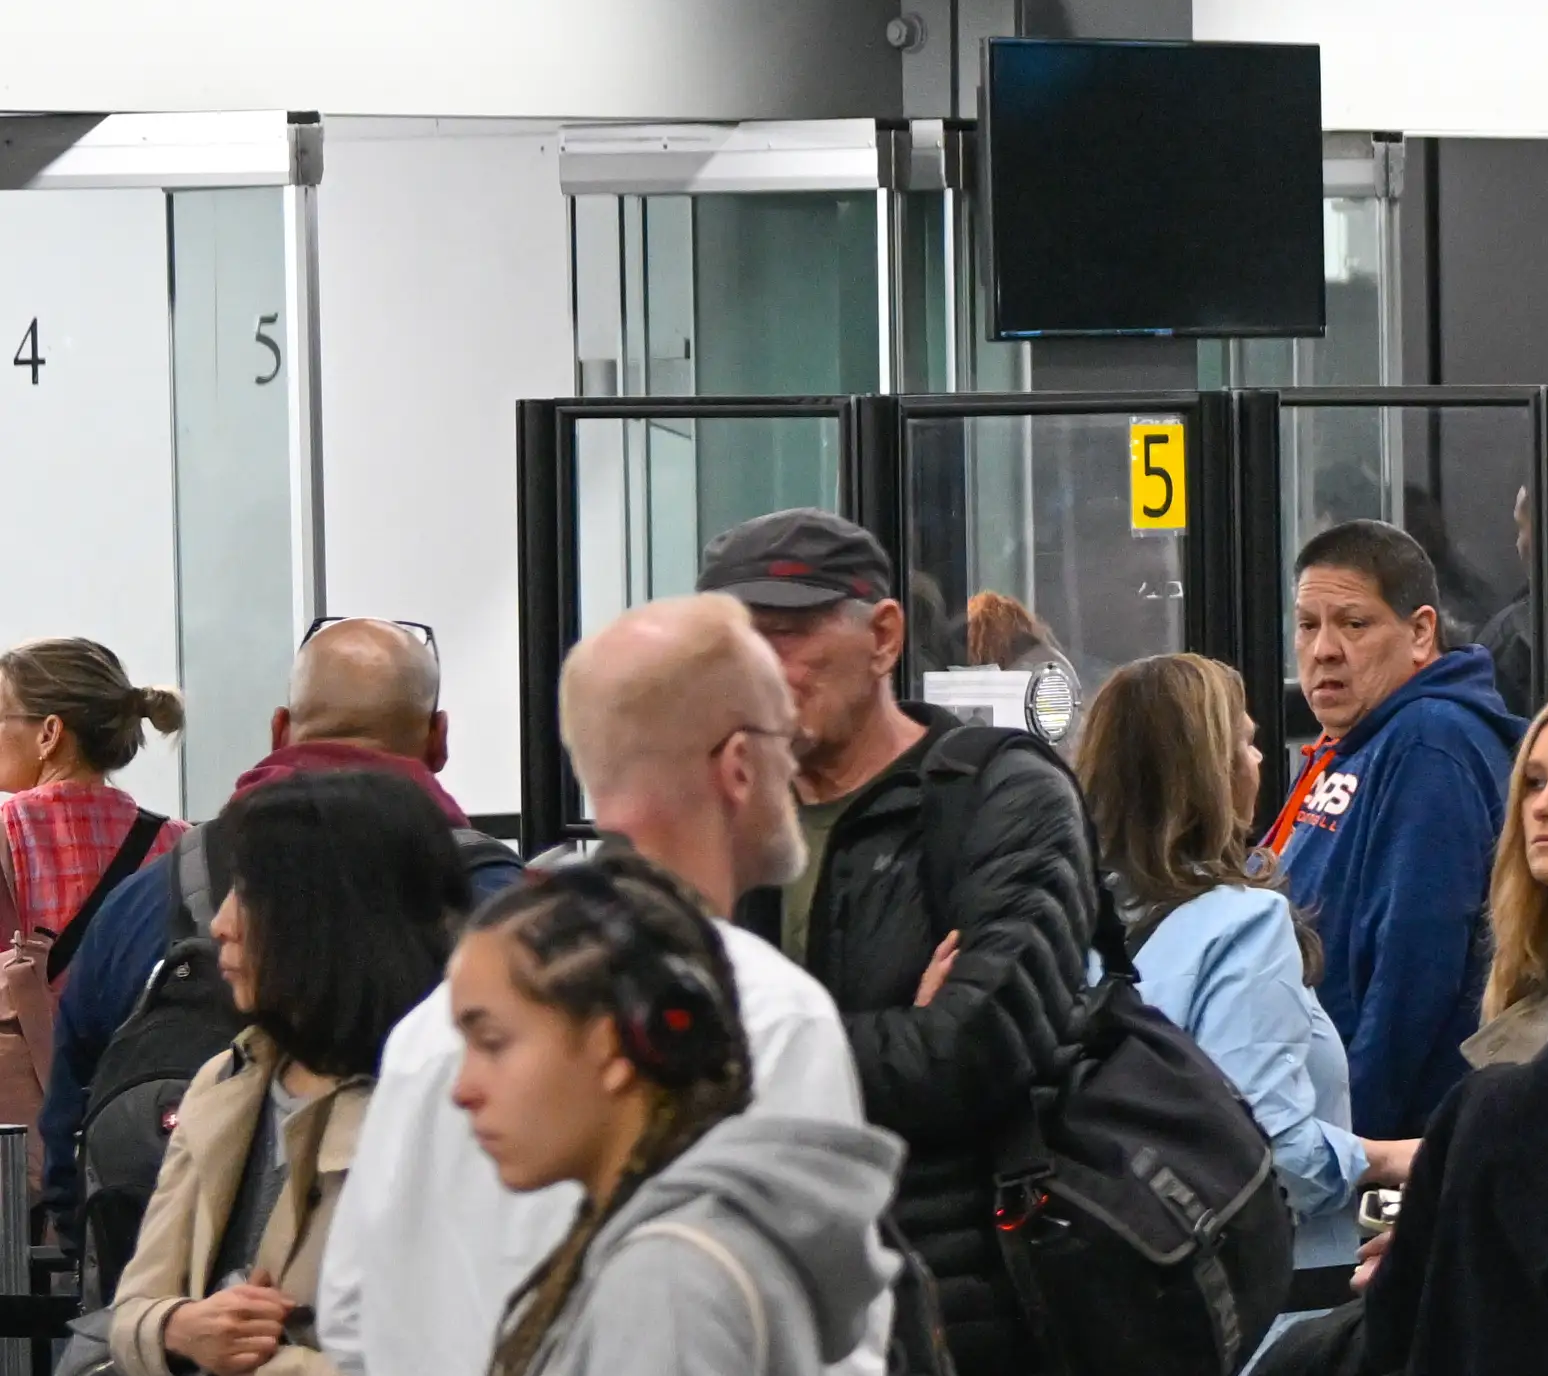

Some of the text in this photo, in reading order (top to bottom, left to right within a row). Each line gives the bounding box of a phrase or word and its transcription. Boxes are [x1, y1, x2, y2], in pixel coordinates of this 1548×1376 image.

[14, 317, 46, 385] 4
[255, 313, 282, 385] 5
[1143, 434, 1173, 519] 5
